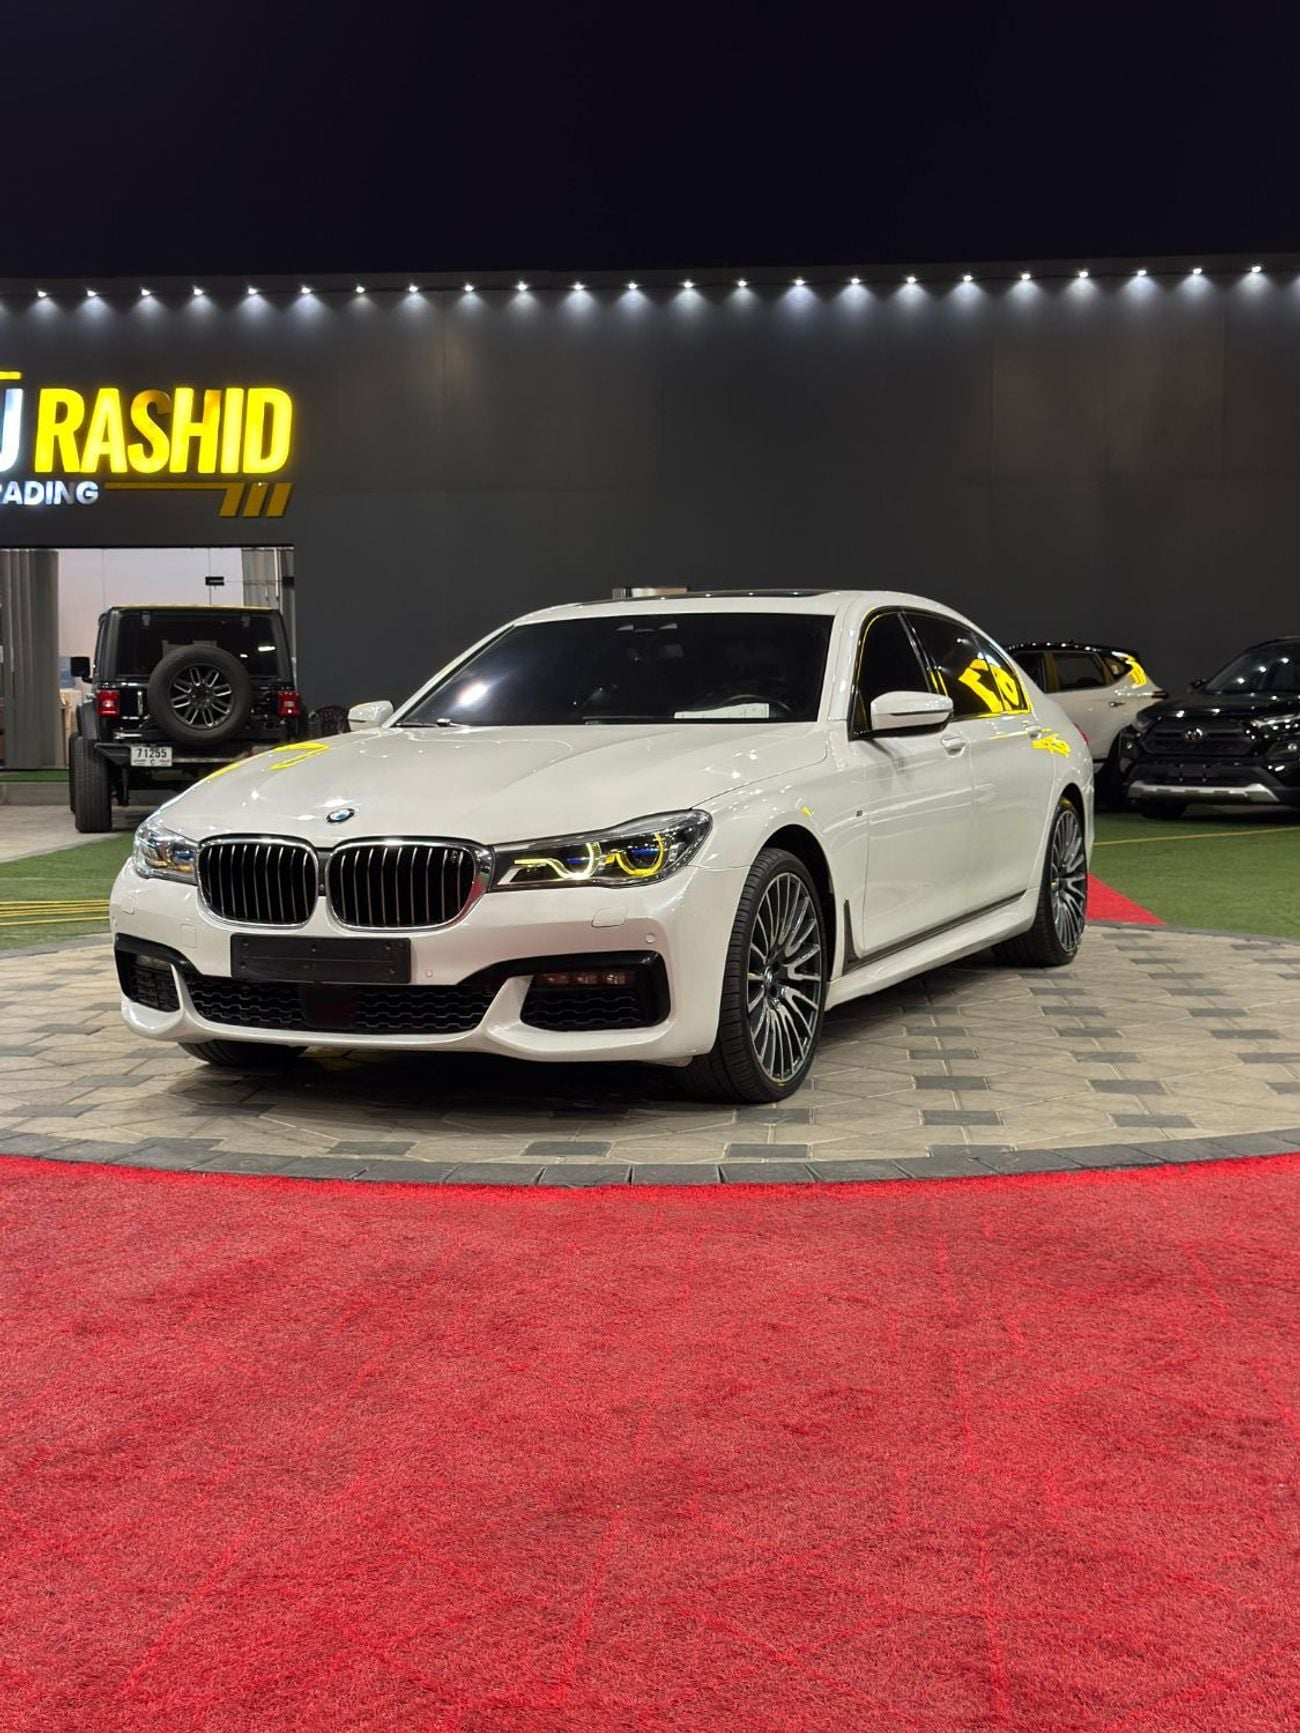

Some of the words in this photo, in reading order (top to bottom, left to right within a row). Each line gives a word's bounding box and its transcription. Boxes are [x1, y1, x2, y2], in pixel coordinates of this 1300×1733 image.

[34, 387, 293, 474] RASHID
[0, 480, 99, 505] ADING
[137, 747, 167, 758] 71255
